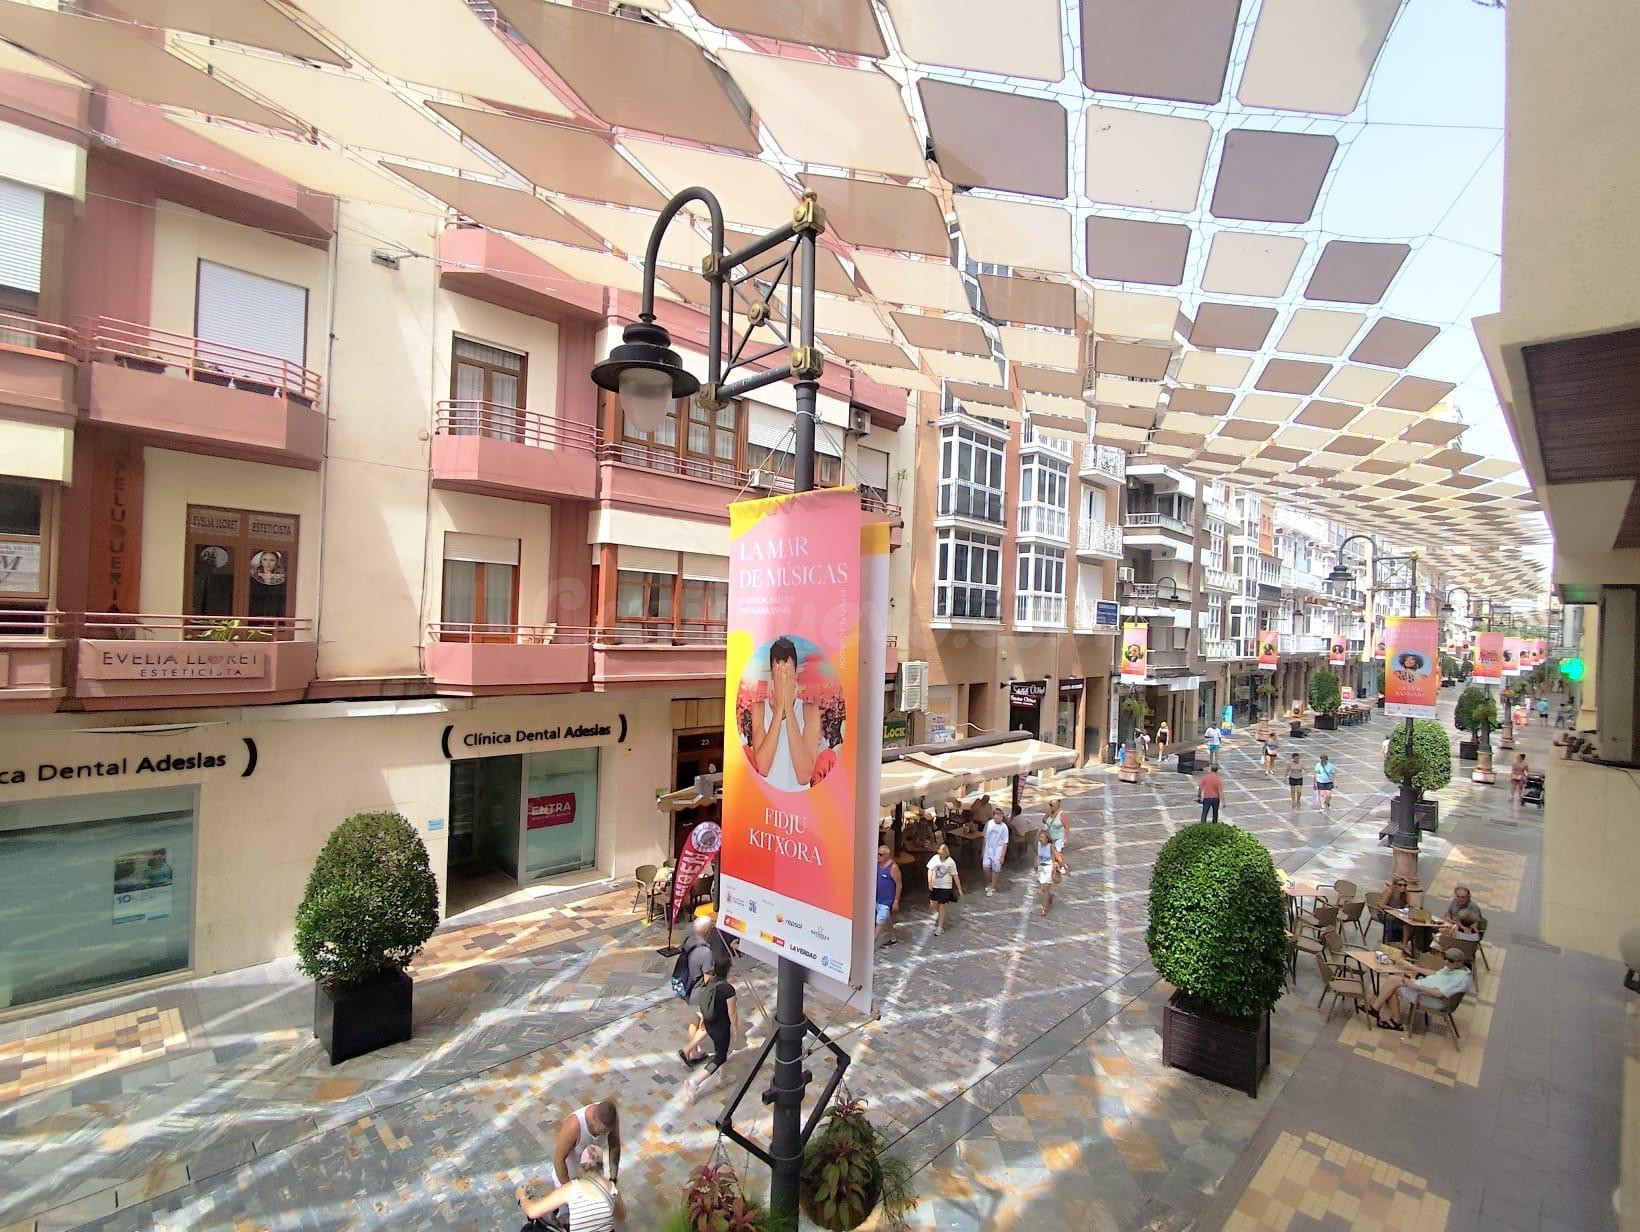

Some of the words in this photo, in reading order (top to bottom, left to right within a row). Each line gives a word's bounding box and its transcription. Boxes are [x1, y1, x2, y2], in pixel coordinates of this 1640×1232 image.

[252, 521, 291, 535] ESTETICISTA
[740, 542, 764, 561] LA
[767, 536, 809, 560] MAR
[740, 568, 764, 588] DE
[767, 561, 848, 588] MÚSICAS
[102, 651, 178, 665] EVELIA
[464, 732, 511, 747] Clínica
[516, 727, 560, 743] Dental
[564, 724, 611, 739] Adeslas
[38, 758, 127, 781] Dental
[136, 752, 226, 774] Adeslas
[531, 802, 571, 816] ENTRA
[764, 807, 808, 835] FIDJU
[749, 828, 823, 866] KITXORA
[785, 919, 803, 929] repsol
[789, 944, 797, 952] LA
[796, 946, 818, 960] VERDAD
